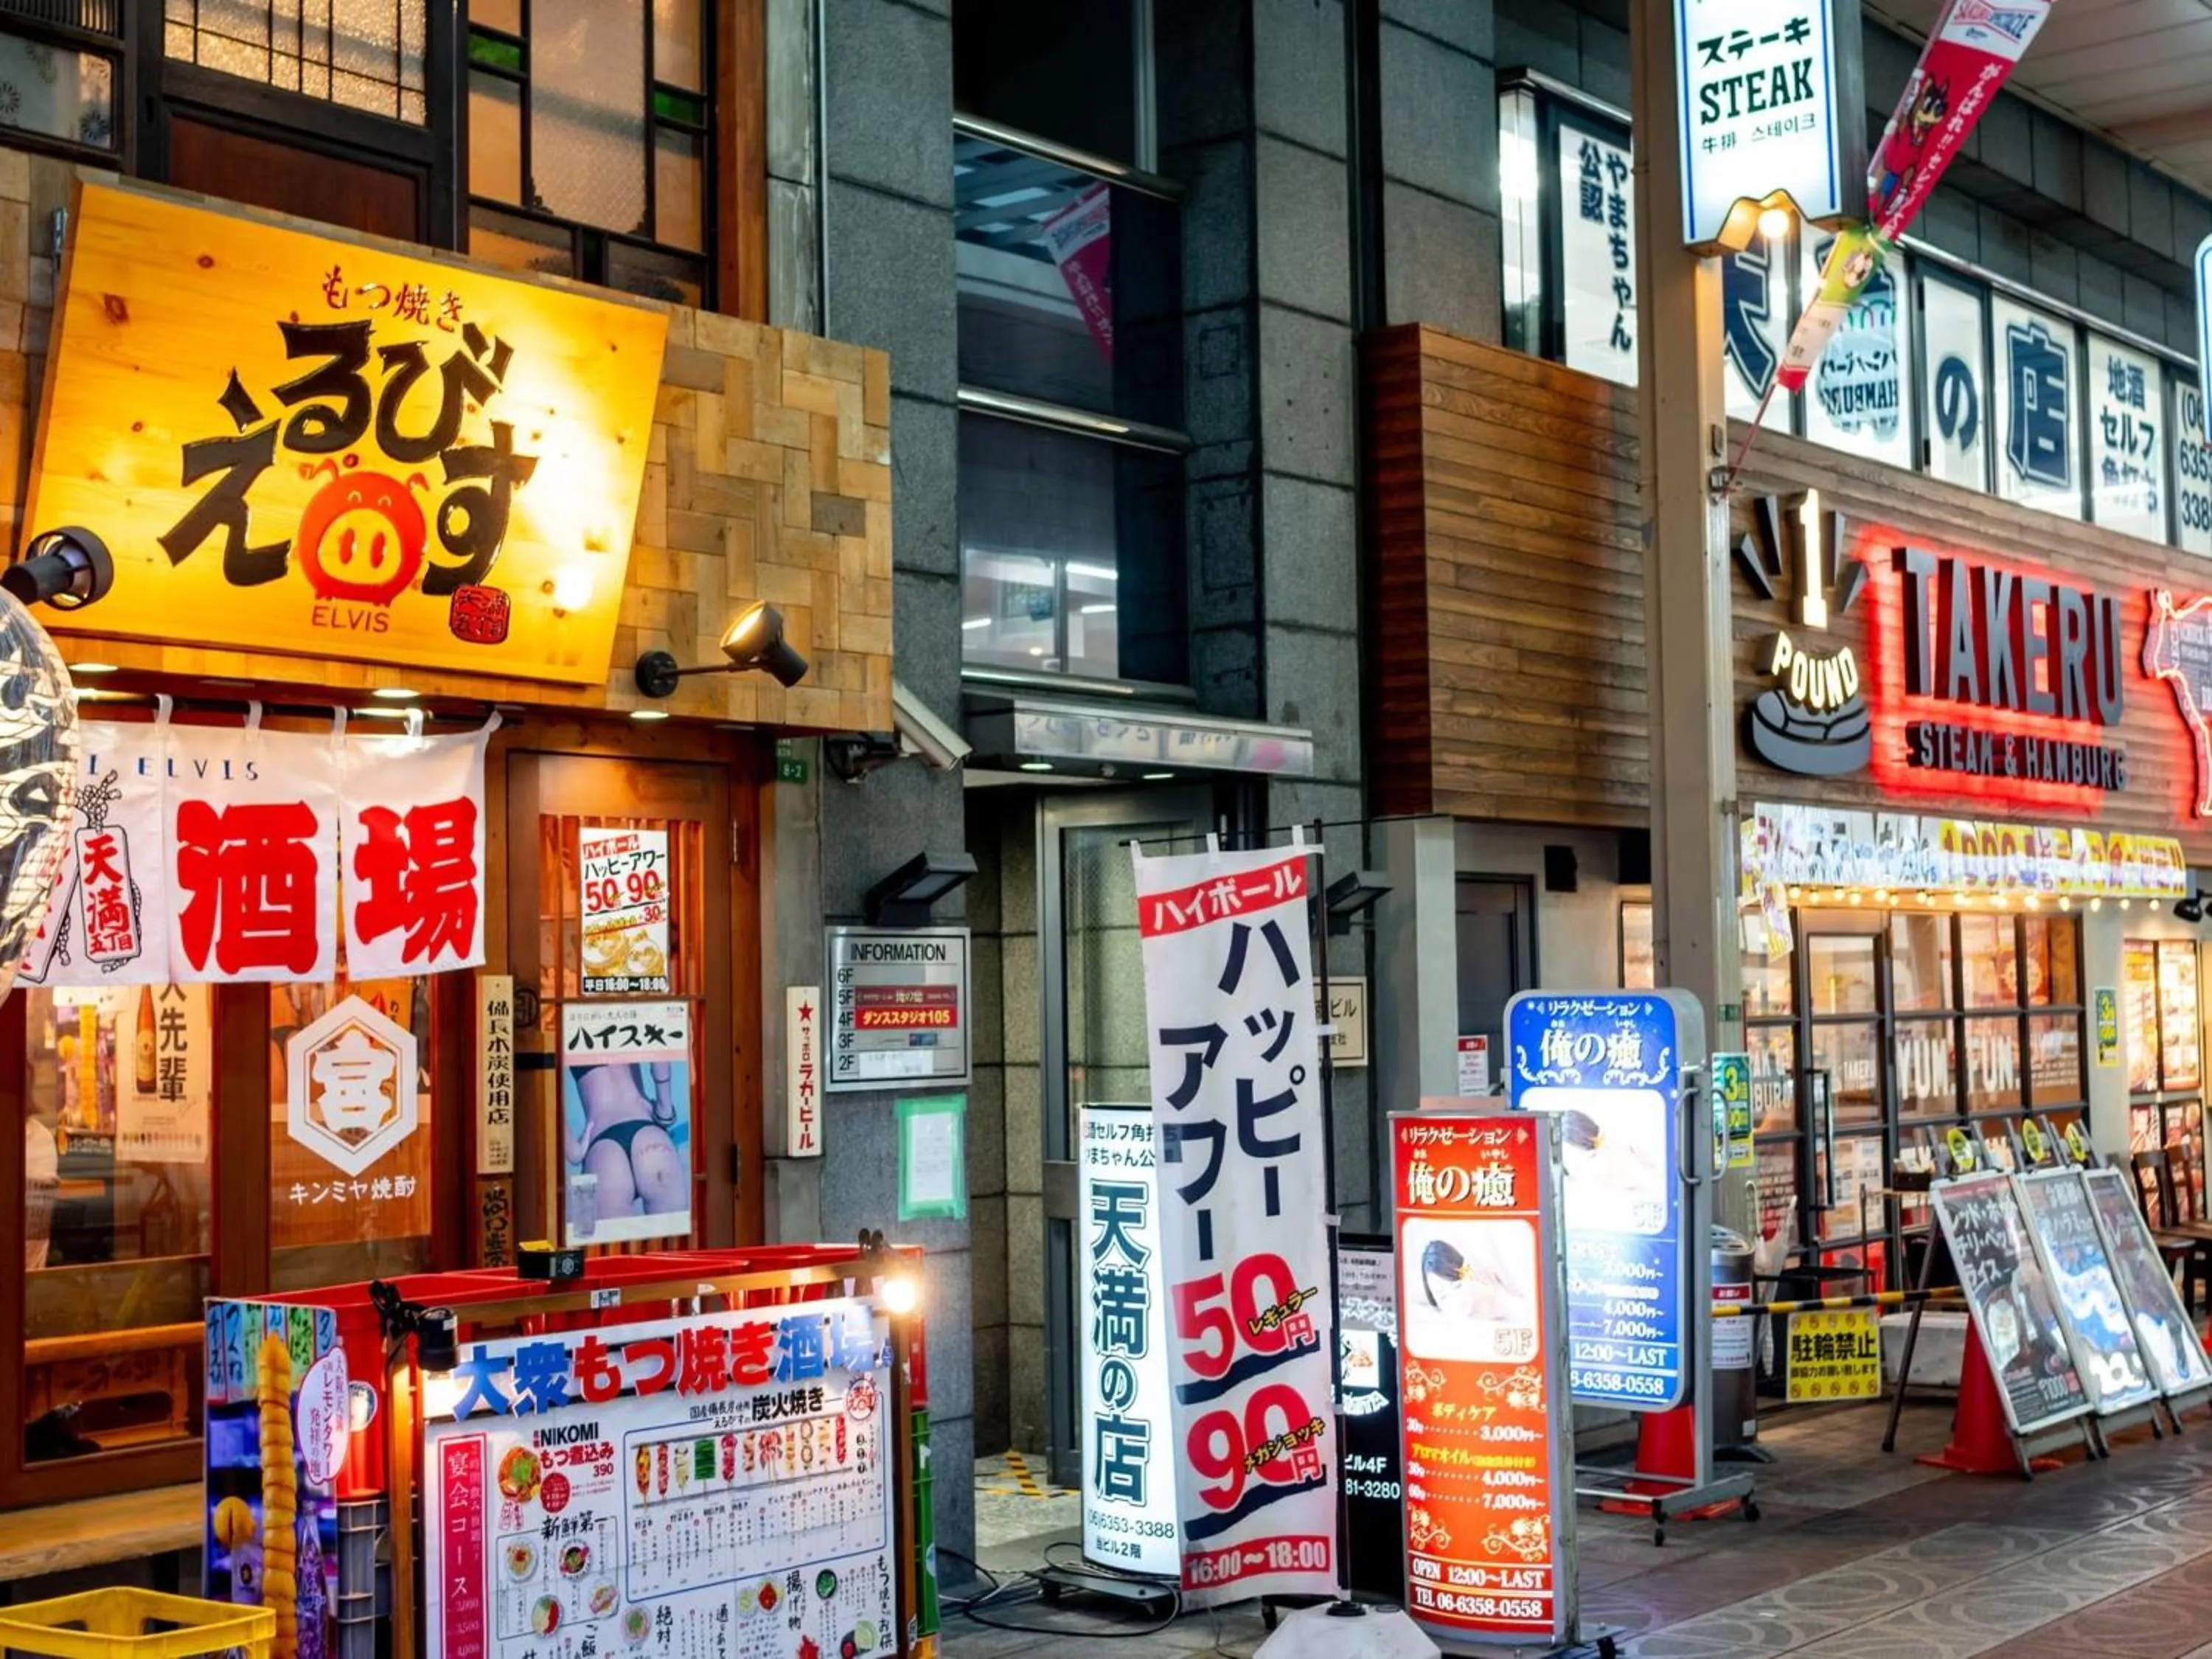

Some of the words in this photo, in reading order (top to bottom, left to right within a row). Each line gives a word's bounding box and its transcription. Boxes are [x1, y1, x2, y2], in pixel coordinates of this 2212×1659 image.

[1697, 17, 1810, 68] ステーキ
[1700, 58, 1815, 125] STEAK
[1751, 112, 1816, 142] 스테이크
[1579, 139, 1604, 223] 公認
[1607, 151, 1632, 354] やまちゃん
[322, 265, 462, 333] もつ焼き
[2107, 355, 2146, 411] 地酒
[157, 319, 538, 595] えるびす
[2100, 406, 2154, 459] セルフ
[2182, 490, 2212, 531] 338
[1800, 488, 1827, 628] 1
[310, 605, 389, 633] ELVIS
[1893, 548, 2123, 726] TAKERU
[1771, 630, 1859, 709] POUND
[1913, 723, 1993, 776] STEAK
[2003, 731, 2017, 777] &
[2025, 741, 2127, 791] HAMBURG
[83, 835, 130, 933] 天満
[176, 795, 479, 975] 酒場
[584, 849, 665, 880] ハッピーアワー
[1153, 864, 1302, 931] ハイボール
[838, 967, 854, 984] 6F
[851, 943, 946, 961] INFORMATION
[838, 989, 855, 1005] 5F
[838, 1012, 855, 1028] 4F
[862, 1009, 950, 1026] ダンススタジオ105
[1548, 1001, 1640, 1017] リラクゼーション
[568, 1023, 684, 1051] ハイスキー
[838, 1033, 855, 1049] 3F
[1540, 1029, 1643, 1069] 俺の癒
[799, 1026, 815, 1150] サッポロラガービール
[838, 1055, 855, 1071] 2F
[1217, 919, 1306, 1217] ハッピー
[1896, 1037, 1957, 1100] YUM.
[1159, 1022, 1228, 1262] アワー
[1409, 1127, 1511, 1145] リラクゼーション
[288, 1175, 418, 1206] キンミヤ焼酎
[1408, 1162, 1516, 1207] 俺の癒
[1248, 1286, 1318, 1336] レギュラー
[451, 1305, 874, 1423] 大衆もつ焼き酒場
[1090, 1178, 1151, 1508] 天満の店
[1792, 1331, 1877, 1363] 駐輪禁止
[751, 1386, 824, 1422] 炭火焼き
[540, 1422, 599, 1447] NIKOMI
[540, 1441, 615, 1469] もつ煮込み
[1244, 1416, 1327, 1475] メガジョッキ
[593, 1462, 614, 1478] 390
[448, 1450, 468, 1597] 宴会コース
[540, 1509, 608, 1542] 新鮮第一
[1412, 1557, 1441, 1580] OPEN
[786, 1570, 803, 1630] 揚げ物
[1415, 1586, 1436, 1607] TEL
[1437, 1592, 1543, 1618] 06-6358-0558
